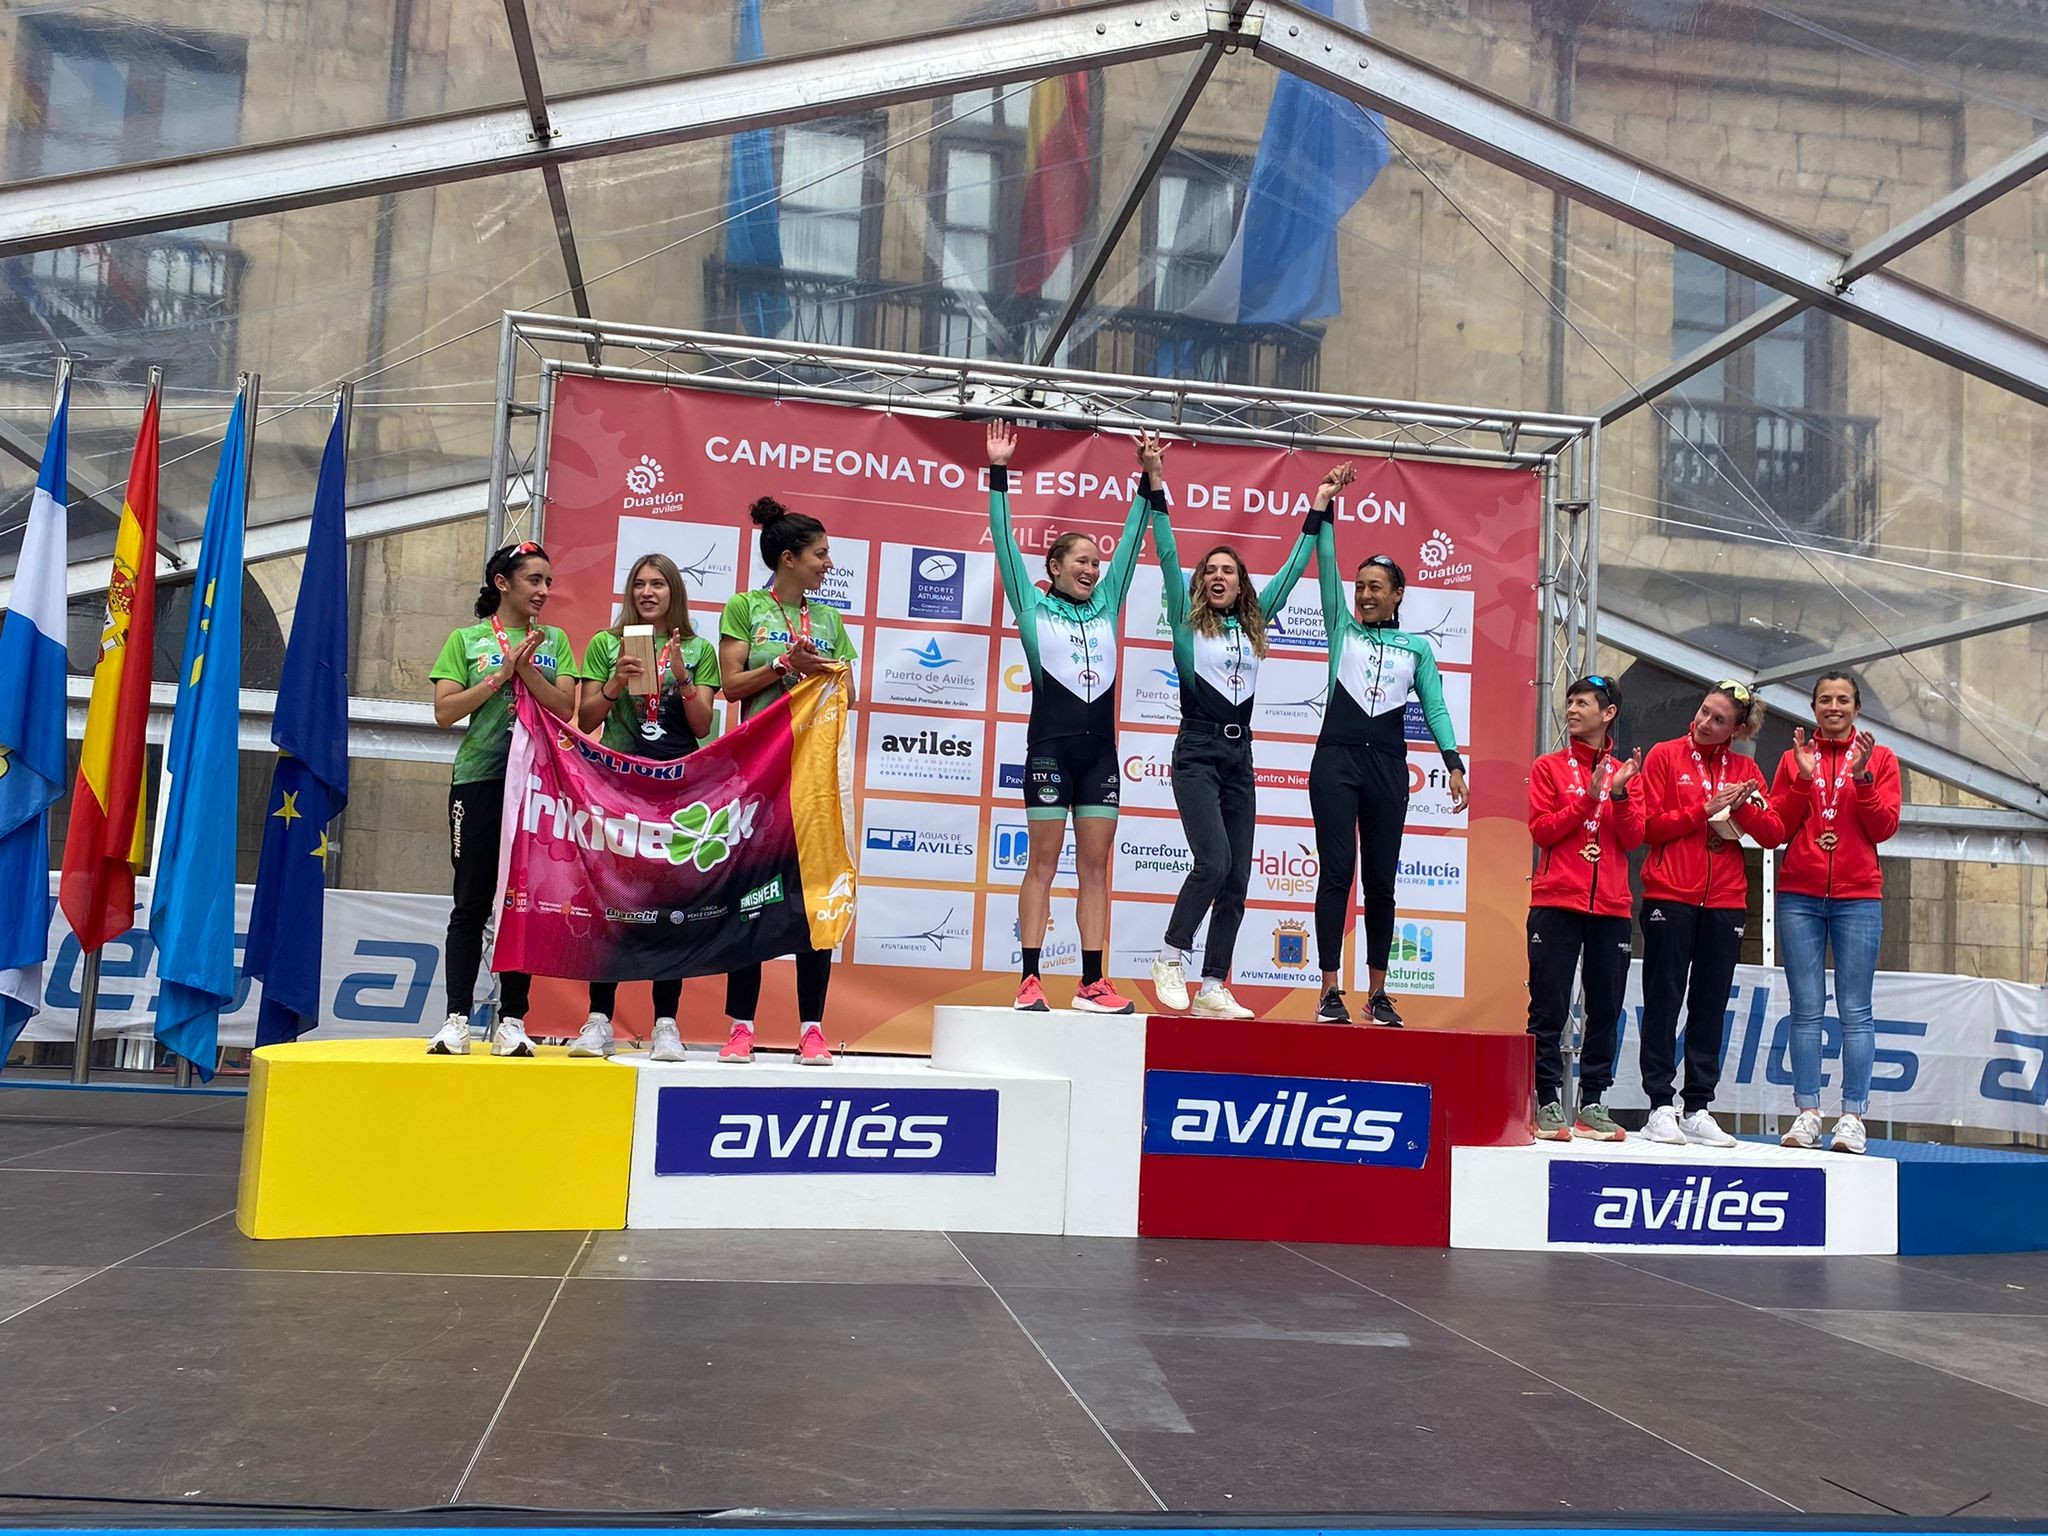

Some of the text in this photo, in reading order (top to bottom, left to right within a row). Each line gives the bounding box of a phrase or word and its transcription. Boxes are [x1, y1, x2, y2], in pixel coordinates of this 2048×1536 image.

[705, 436, 965, 489] CAMPEONATO
[978, 467, 1023, 495] DE
[1187, 483, 1231, 511] DE
[1243, 488, 1406, 526] DUALÓN
[624, 491, 684, 509] Duatlón
[978, 525, 1068, 549] AILÉ
[708, 564, 732, 572] AVILÉS
[1418, 563, 1472, 582] Duatlón
[918, 584, 954, 594] DEPORTE
[917, 592, 954, 602] ASTURIANO
[1287, 617, 1324, 627] DEPORT
[490, 654, 556, 669] SOKI
[885, 668, 975, 686] Puerto de Avilés
[890, 694, 917, 703] Autoridad
[918, 697, 944, 706] Portuaria
[1136, 688, 1170, 700] Puerto
[1265, 709, 1308, 719] AYUNTAMIENTO
[879, 770, 933, 778] convention
[918, 831, 961, 841] AGUAS DE
[916, 840, 973, 856] AVILÉS
[1121, 841, 1188, 858] Carrefour
[740, 881, 780, 908] FINISHER
[1266, 877, 1314, 897] viajes
[606, 908, 659, 921] Bianchi
[880, 927, 969, 952] AYUNTAMIENTO AVILÉS
[1011, 941, 1076, 964] Dtlón
[1042, 955, 1076, 969] aviles
[1240, 970, 1306, 982] AYUNTAMIENTO
[1387, 967, 1435, 981] Asturias
[1410, 982, 1435, 990] natural
[1171, 1090, 1404, 1154] avilés
[709, 1100, 949, 1160] avilés
[1593, 1176, 1789, 1233] avilés
